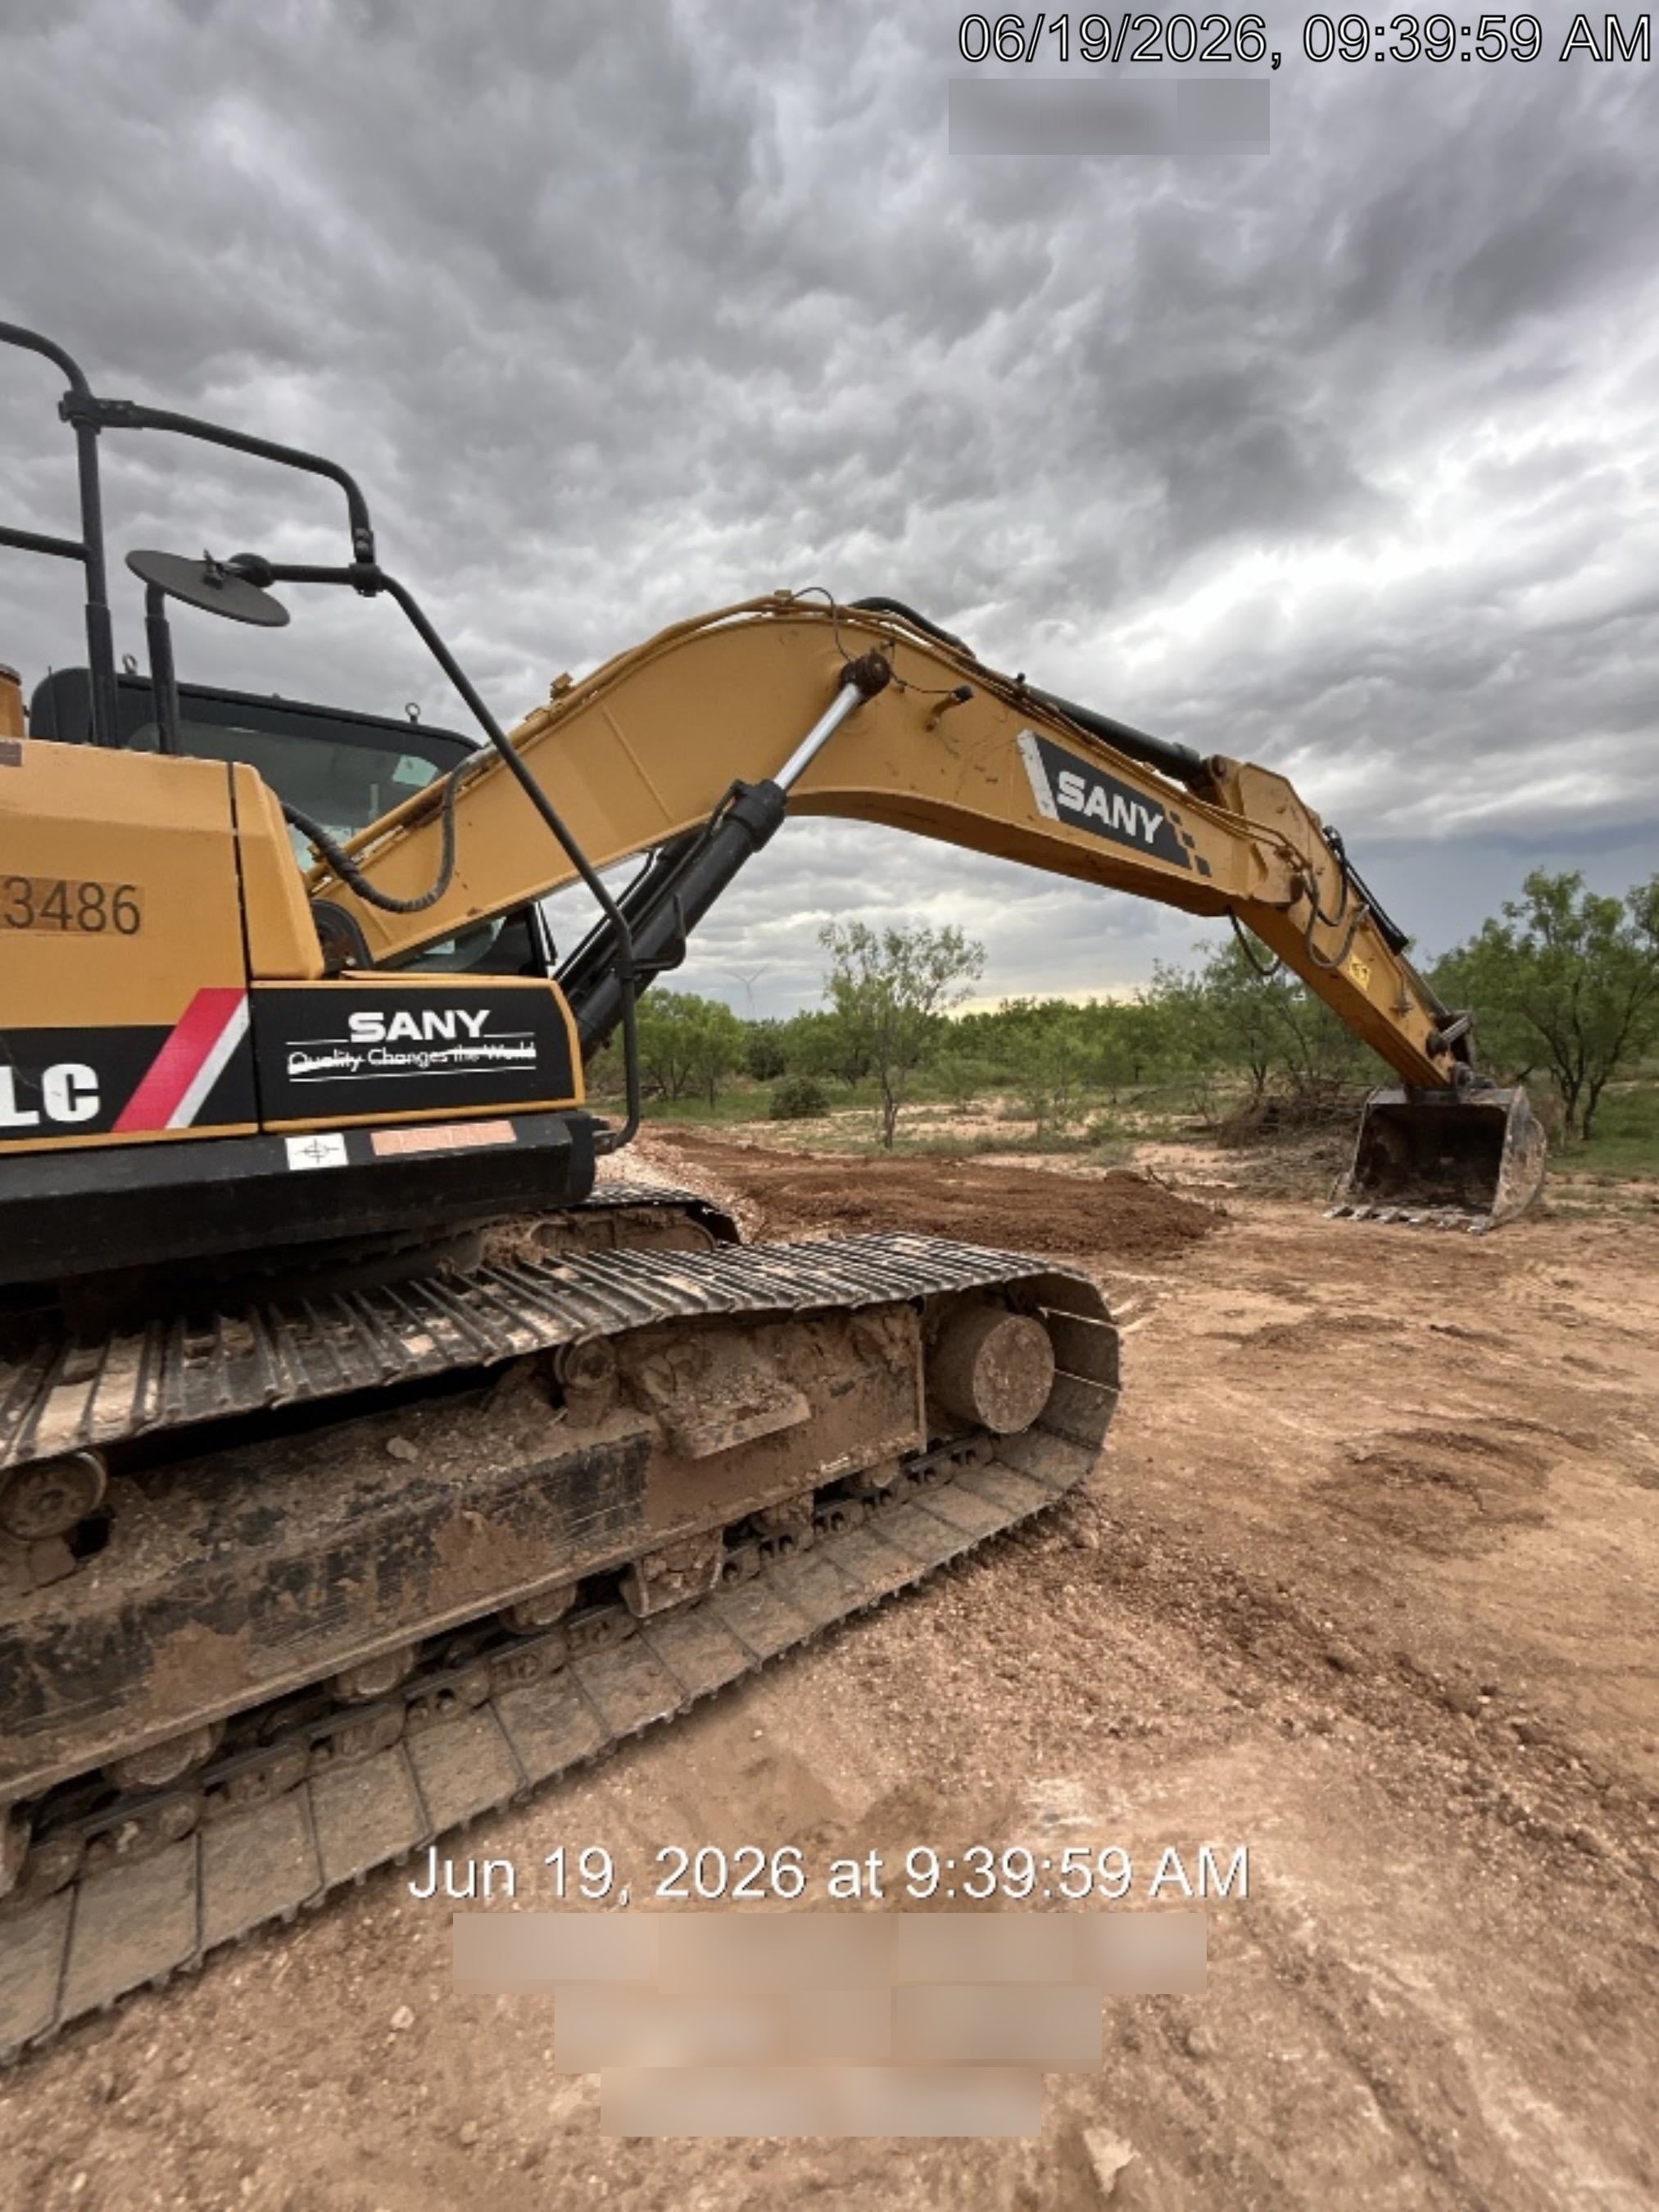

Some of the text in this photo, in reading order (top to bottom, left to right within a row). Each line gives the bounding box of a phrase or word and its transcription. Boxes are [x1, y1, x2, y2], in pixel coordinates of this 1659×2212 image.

[1057, 771, 1163, 844] SANY
[3, 876, 140, 935] 3486
[348, 1009, 490, 1043] SANY
[368, 1047, 447, 1068] Changes
[0, 1063, 100, 1126] LC
